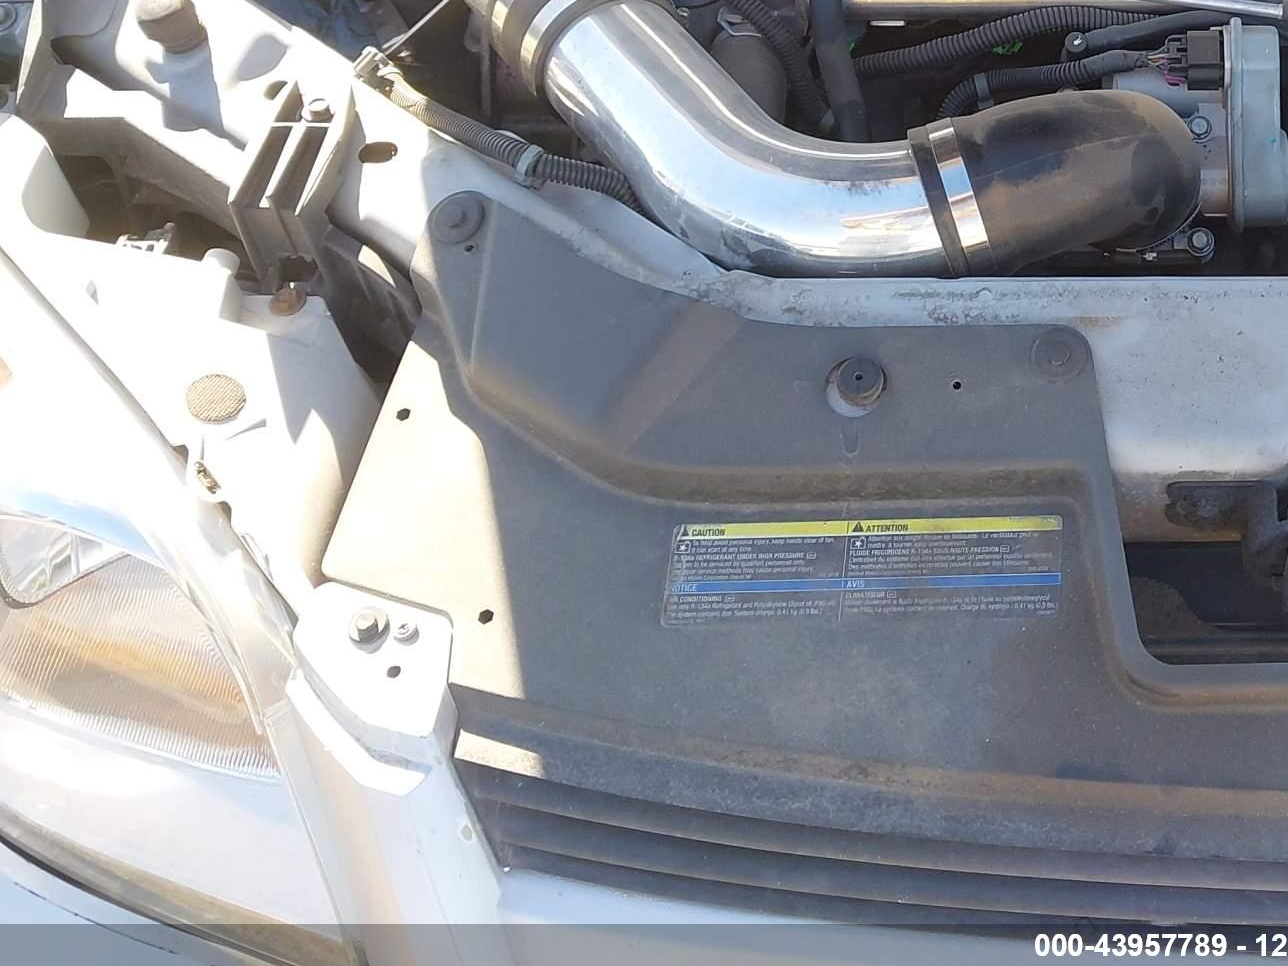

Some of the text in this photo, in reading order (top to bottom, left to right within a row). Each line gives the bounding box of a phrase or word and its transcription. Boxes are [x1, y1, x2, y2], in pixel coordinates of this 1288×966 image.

[865, 524, 908, 532] ATTENTION
[691, 529, 726, 537] CAUTION
[846, 579, 865, 588] AVIS
